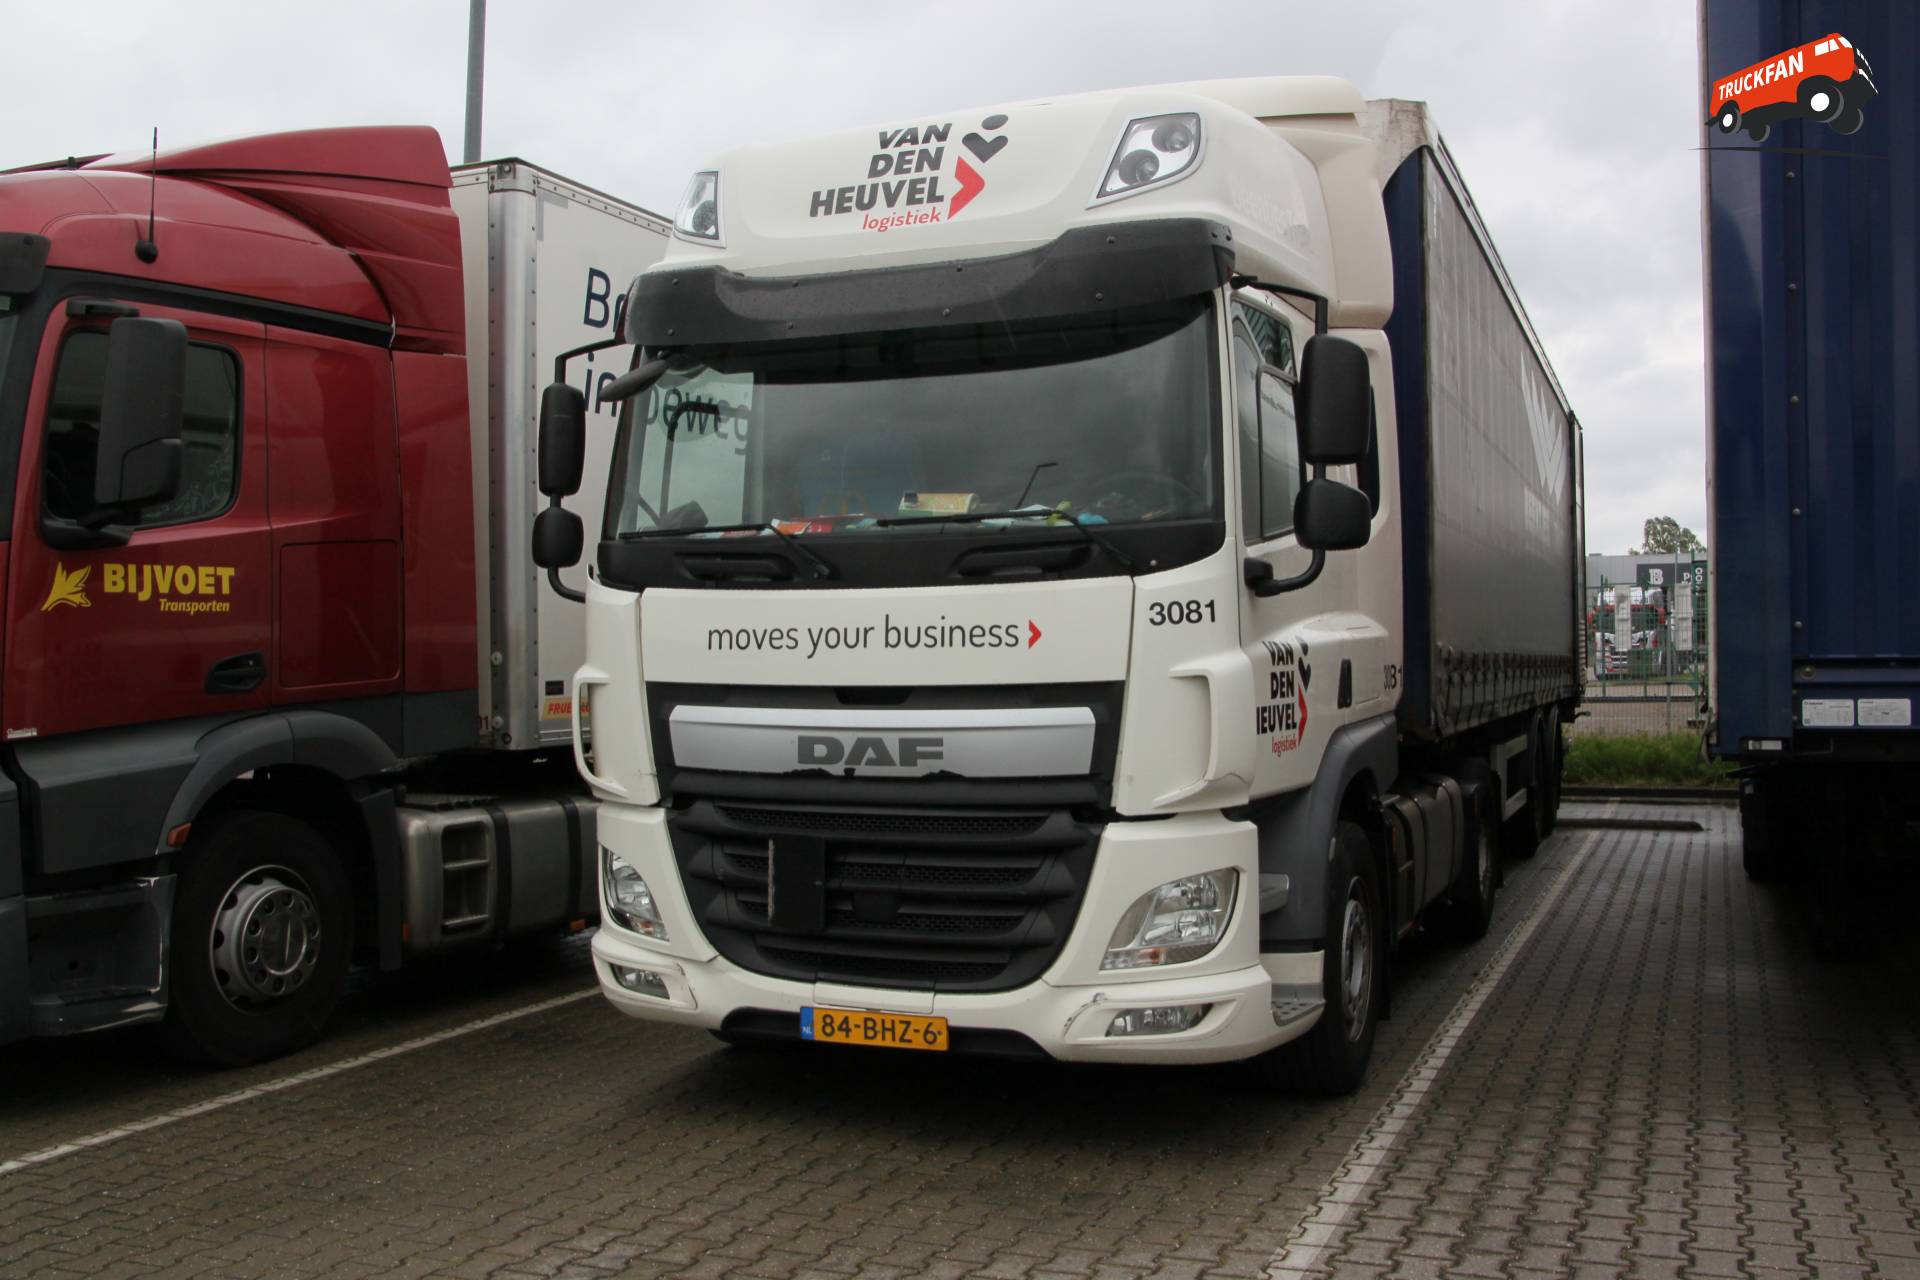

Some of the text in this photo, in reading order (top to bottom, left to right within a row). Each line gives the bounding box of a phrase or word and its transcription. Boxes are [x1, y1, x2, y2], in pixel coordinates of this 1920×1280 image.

[878, 122, 953, 150] VAN
[867, 146, 945, 179] DEN
[809, 175, 945, 218] HEUVEL
[862, 206, 942, 233] logistiek
[103, 562, 235, 602] BIJVOET
[159, 598, 230, 616] Transporten
[1149, 599, 1216, 626] 3081
[708, 613, 1019, 660] moves your business
[1262, 640, 1294, 666] VAN
[1270, 670, 1295, 700] DEN
[798, 735, 944, 767] DAF
[821, 1013, 938, 1046] 84-BHZ-6
